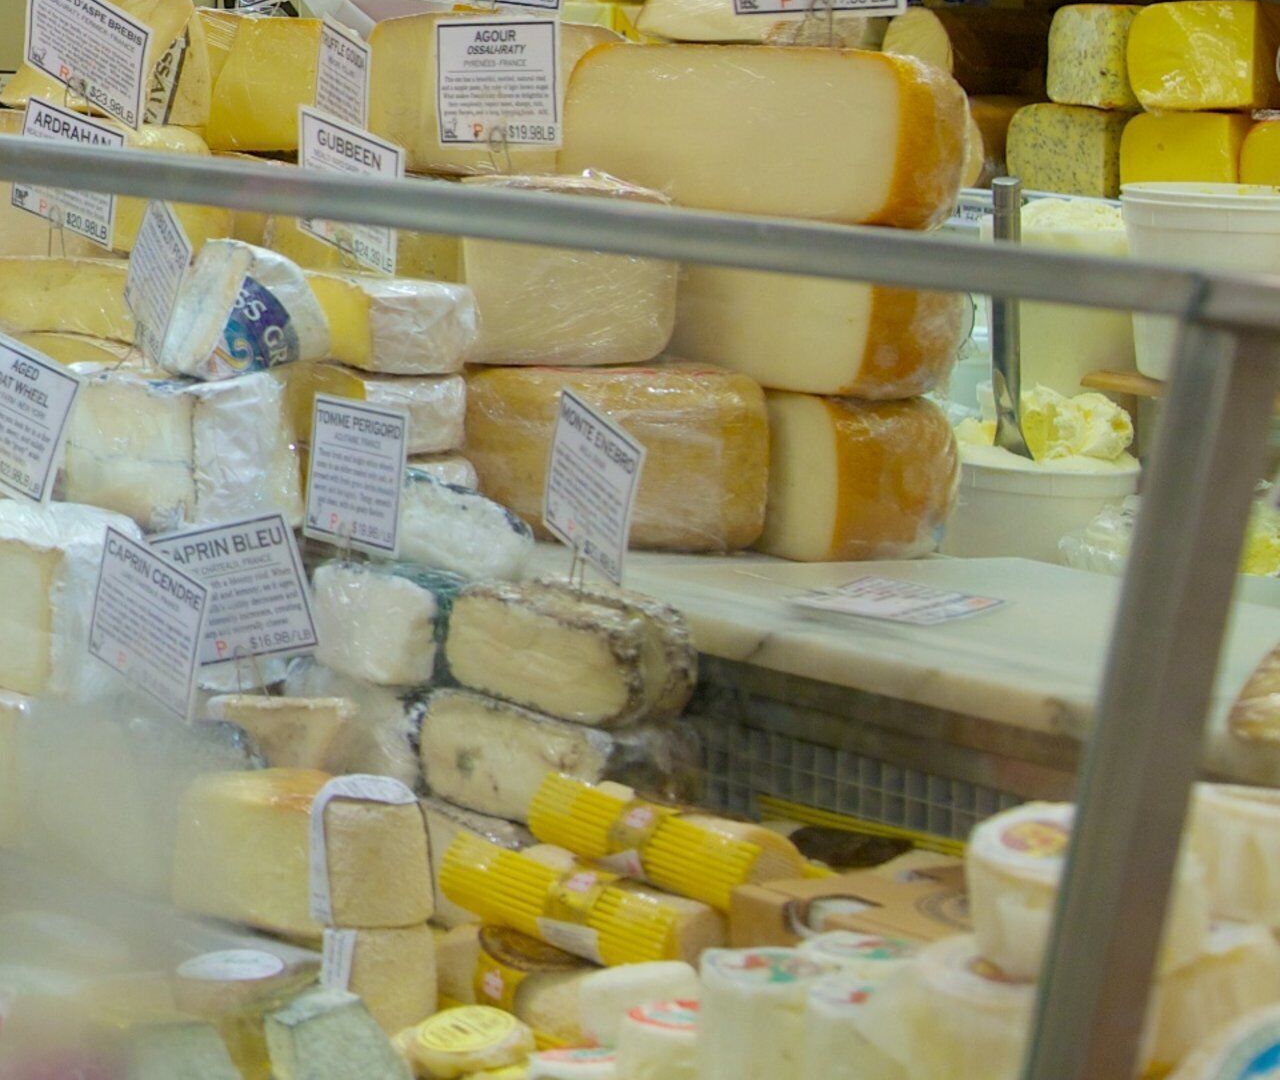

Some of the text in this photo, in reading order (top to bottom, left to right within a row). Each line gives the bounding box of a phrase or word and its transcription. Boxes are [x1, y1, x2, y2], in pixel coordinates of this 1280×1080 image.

[108, 19, 142, 45] BREBIS
[474, 30, 516, 42] AGOUR
[317, 129, 382, 170] GUBBEEN
[11, 358, 40, 381] AGED
[13, 378, 49, 409] WHEEL
[317, 409, 402, 441] TOMME PERIGORD
[562, 402, 635, 475] MONTE ENEBRO
[233, 526, 283, 554] BLEU
[108, 540, 150, 578] CAPRIN
